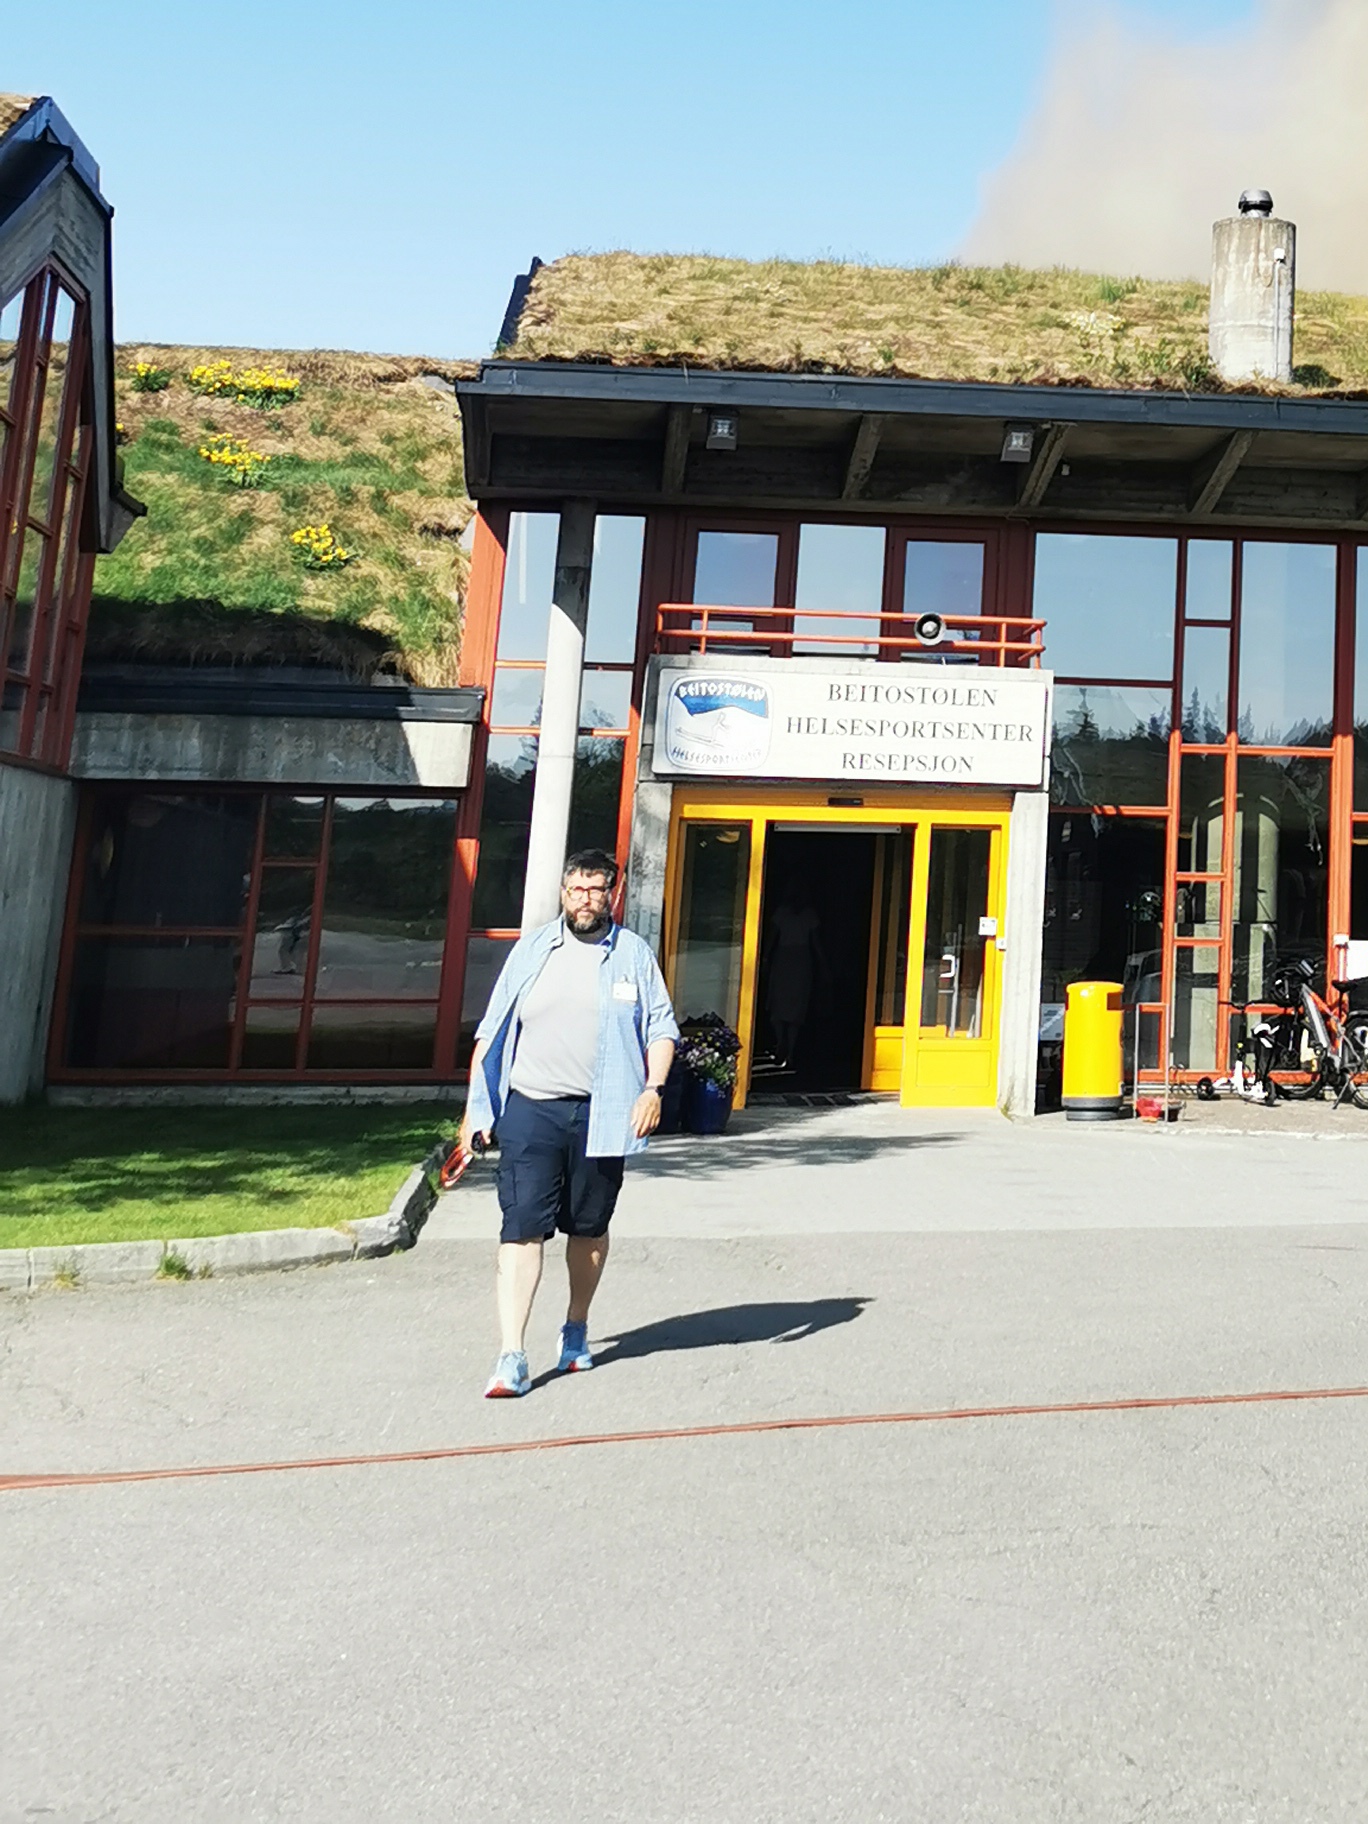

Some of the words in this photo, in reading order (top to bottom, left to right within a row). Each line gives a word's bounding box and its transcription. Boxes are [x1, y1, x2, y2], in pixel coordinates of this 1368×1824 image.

[827, 683, 998, 707] BEITOSTØLEN
[787, 716, 1033, 742] HELSESPORTSENTER
[842, 752, 974, 774] RESEPSJON
